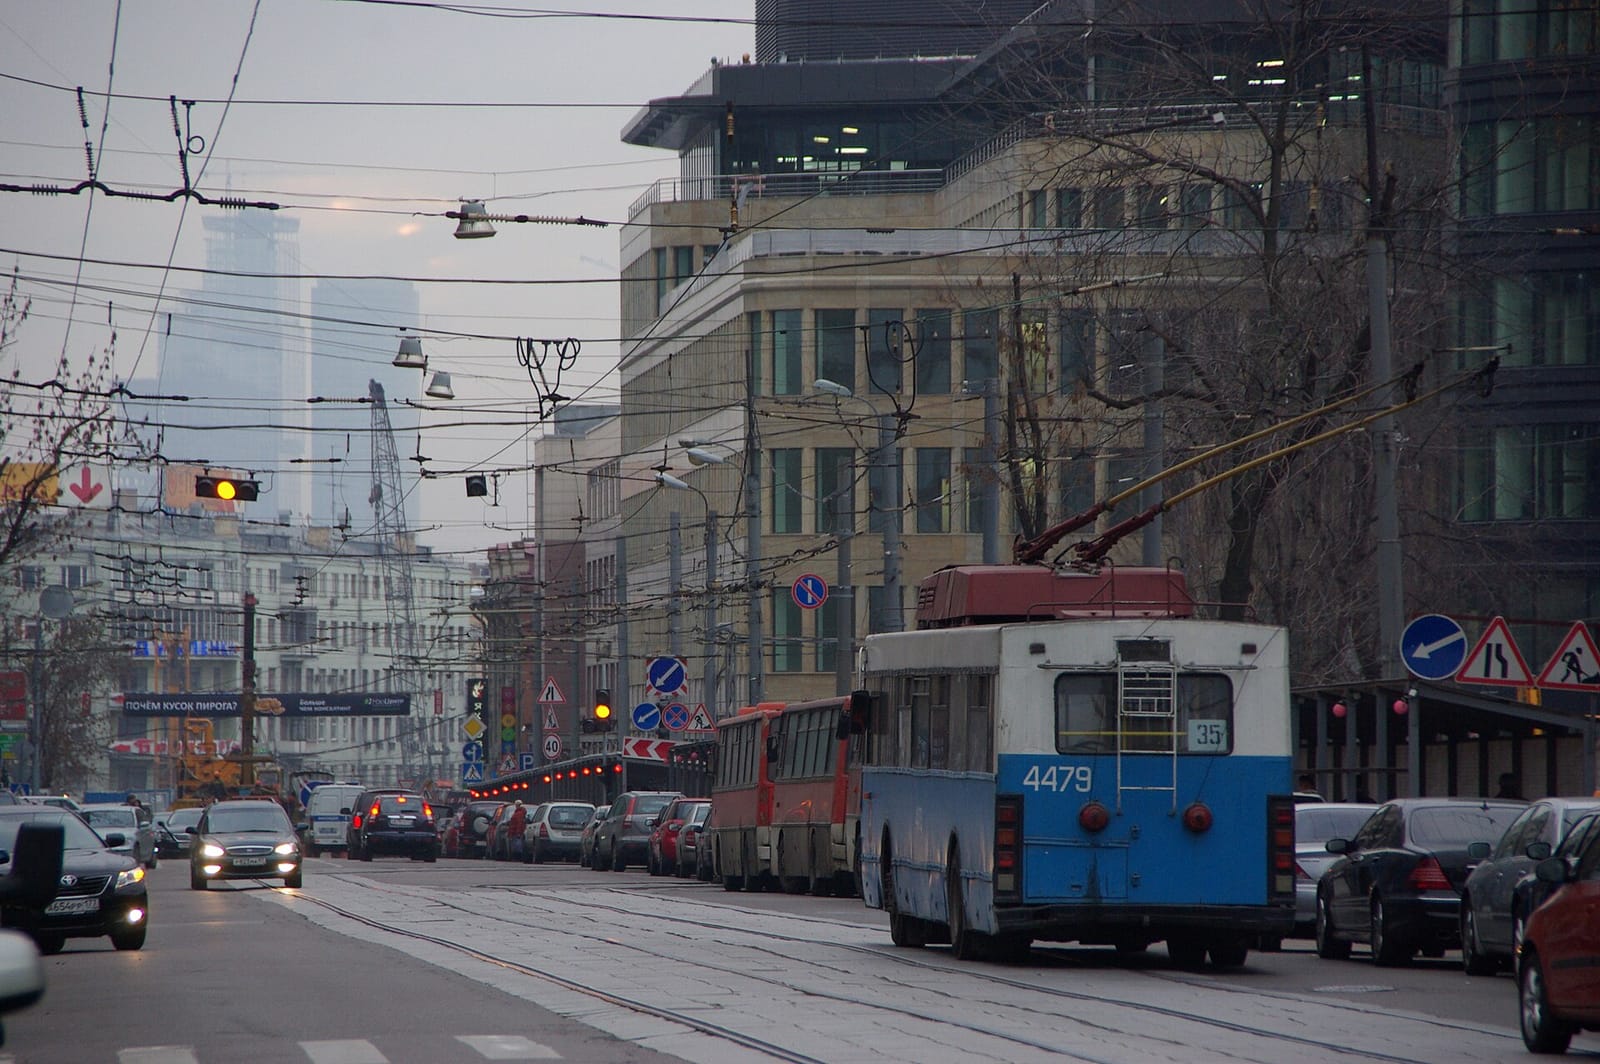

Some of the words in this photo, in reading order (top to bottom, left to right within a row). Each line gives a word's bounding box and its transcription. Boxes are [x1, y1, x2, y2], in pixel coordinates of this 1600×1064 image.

[126, 700, 161, 711] ПОЧЁМ
[163, 701, 194, 711] КУСОК
[196, 701, 238, 711] ПИРОГА?
[545, 740, 558, 752] 40
[523, 754, 534, 769] P
[1022, 765, 1092, 793] 4479
